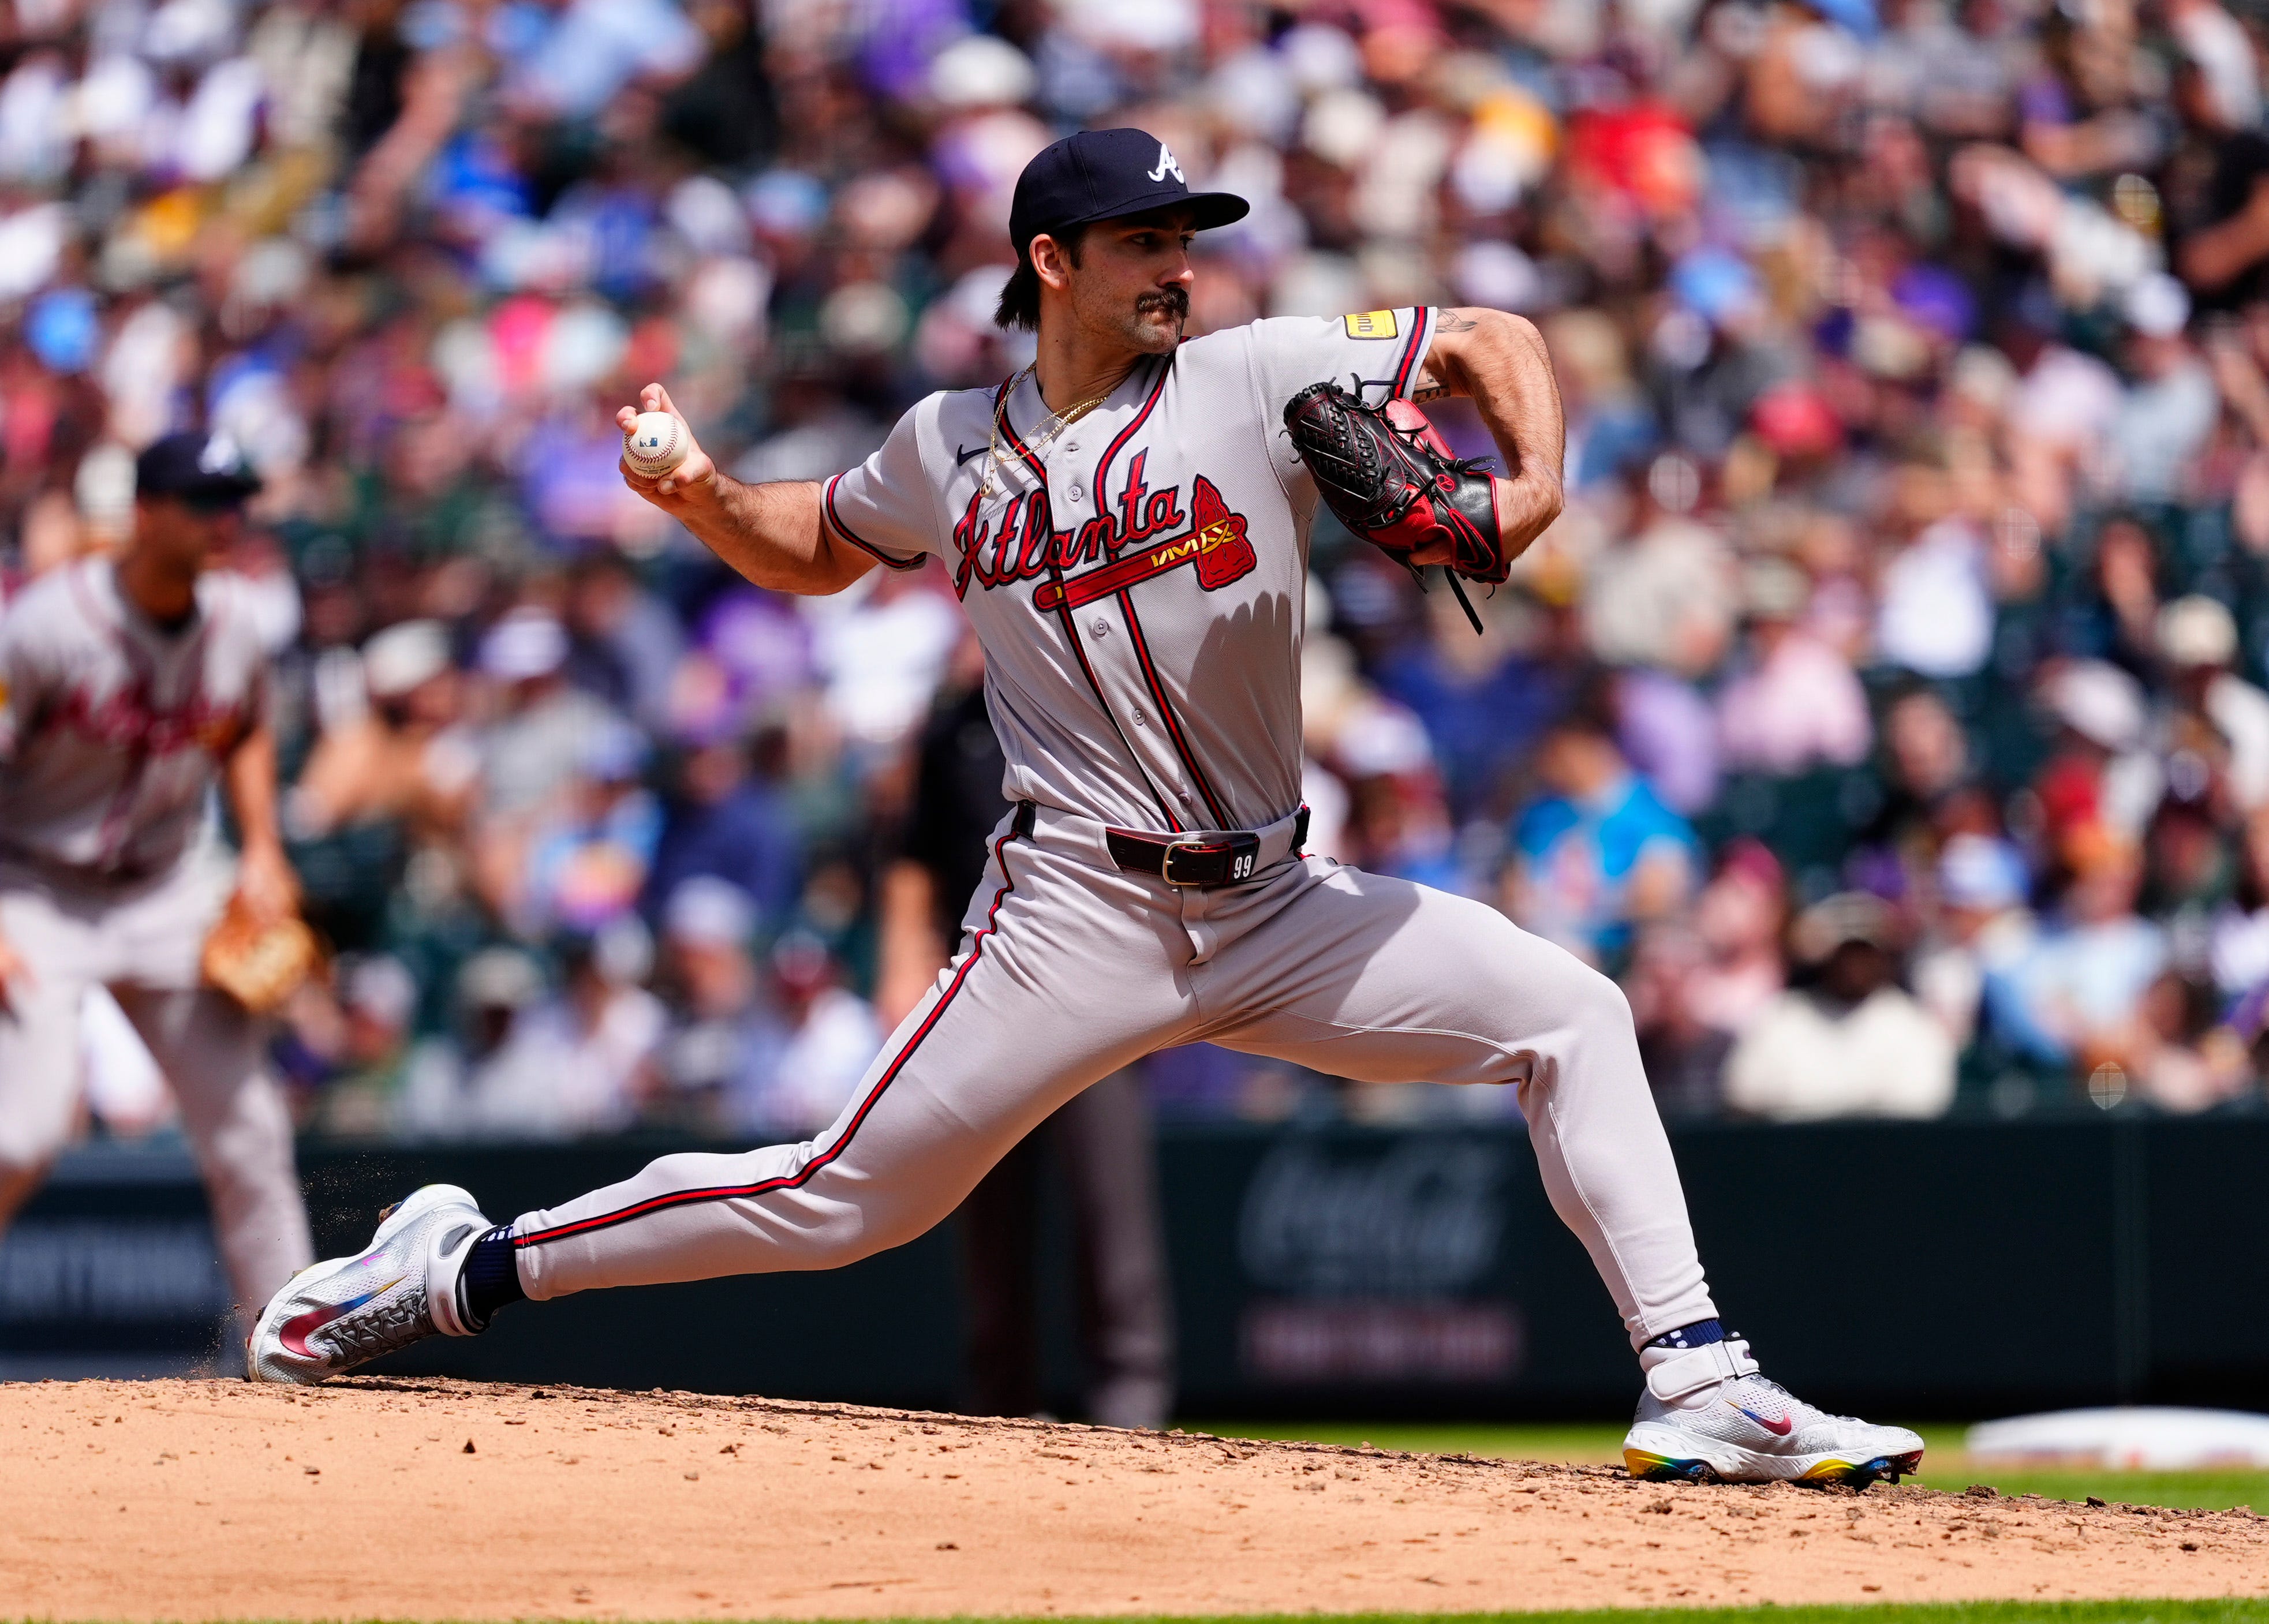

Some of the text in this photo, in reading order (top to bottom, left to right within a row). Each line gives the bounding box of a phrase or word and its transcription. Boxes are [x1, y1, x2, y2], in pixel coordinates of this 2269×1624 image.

[1147, 143, 1184, 184] A
[952, 447, 1185, 603] Atlanta
[1233, 855, 1252, 879] 99
